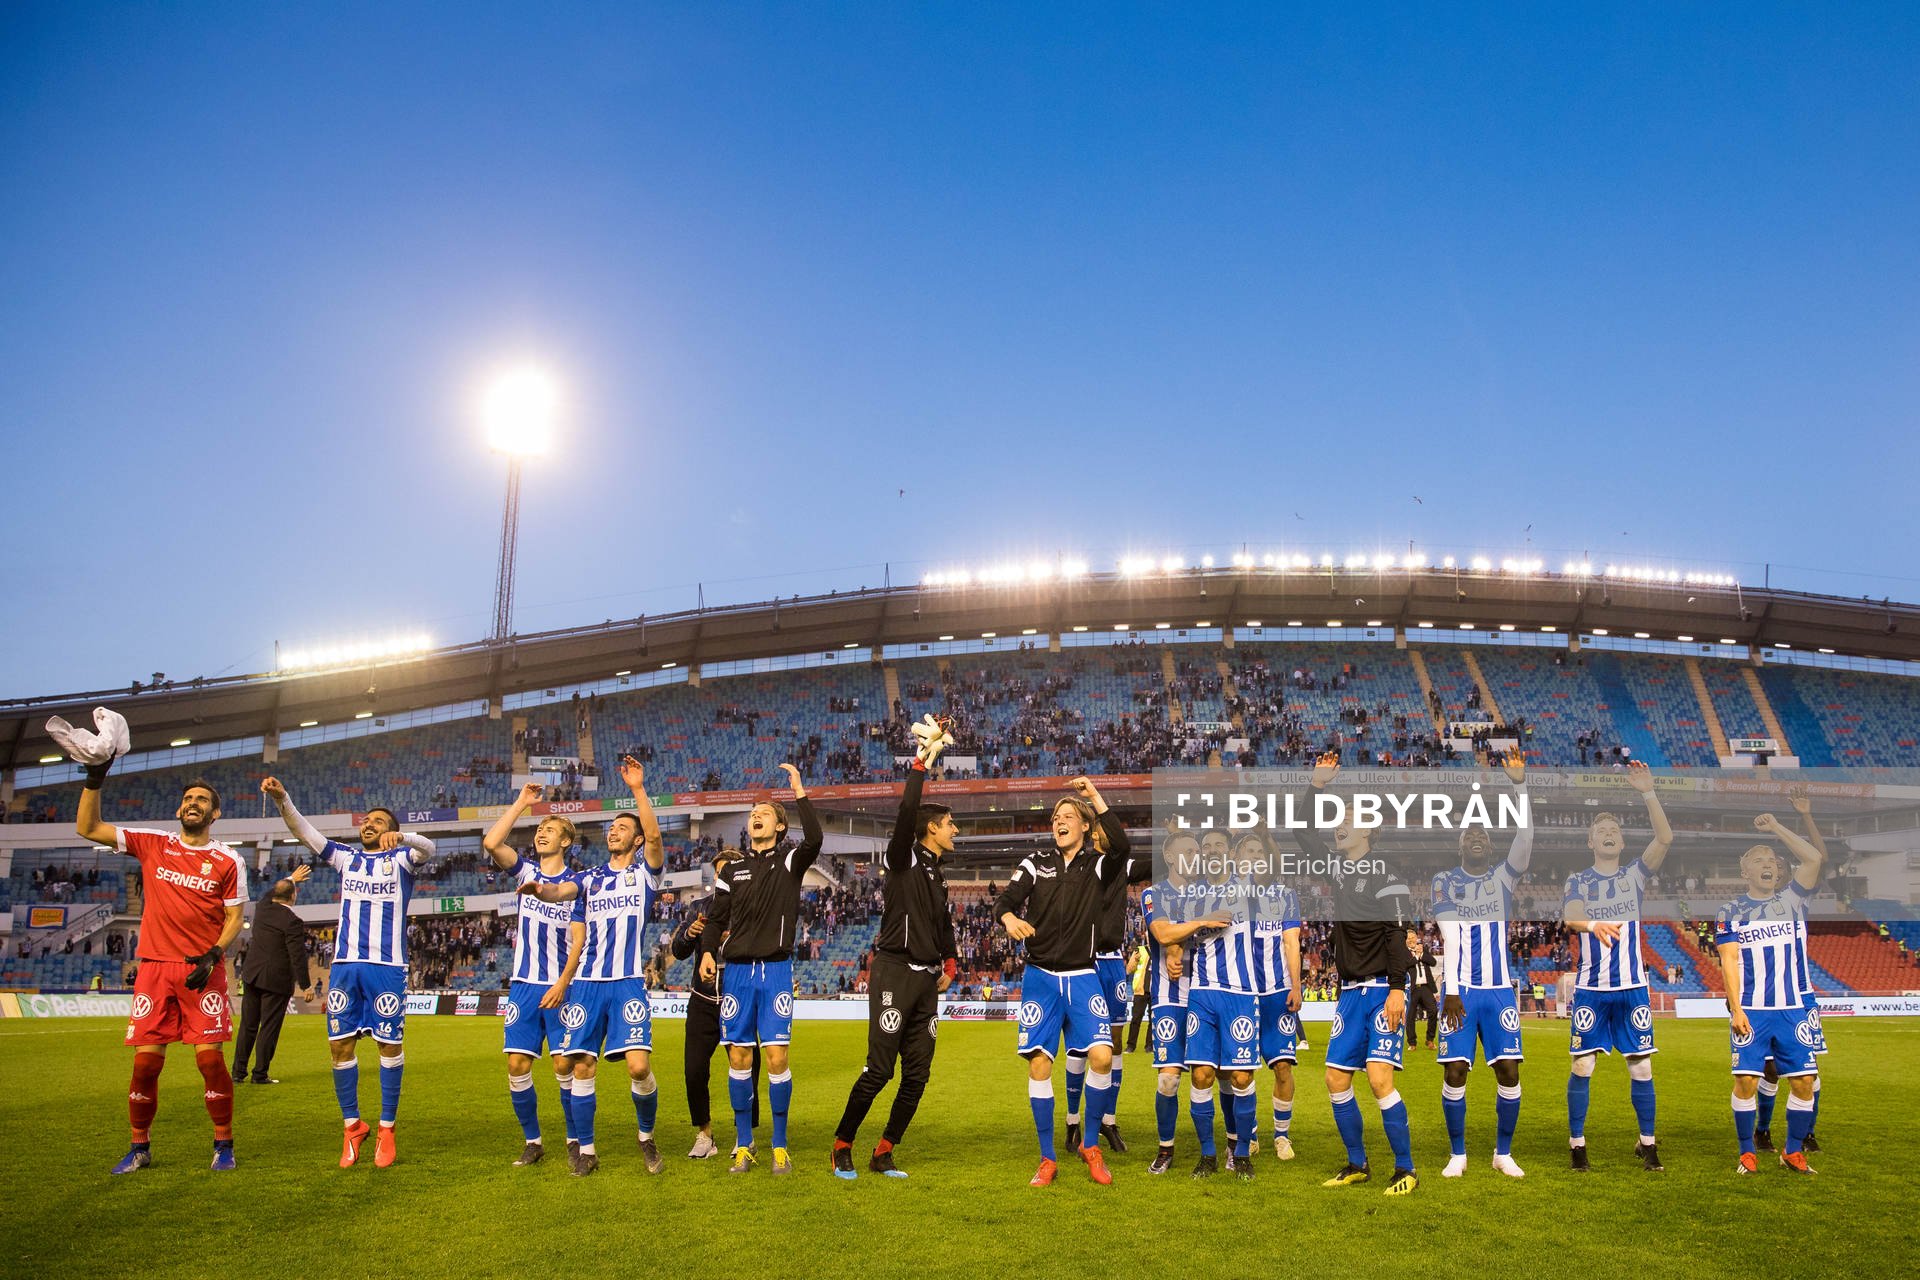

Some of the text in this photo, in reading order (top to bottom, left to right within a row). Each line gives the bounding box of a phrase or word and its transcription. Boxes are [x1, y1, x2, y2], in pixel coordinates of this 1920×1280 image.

[1279, 772, 1312, 783] Ullev
[1358, 772, 1396, 783] Ullevi
[1437, 772, 1475, 784] Ullevi
[1527, 773, 1554, 785] llevi
[1582, 775, 1597, 783] Dit
[1600, 775, 1611, 783] du
[1654, 777, 1687, 786] du vill.
[1726, 781, 1757, 791] Renova
[1807, 784, 1838, 794] Renova
[550, 802, 585, 813] SHOP.
[408, 810, 434, 823] EAT.
[156, 866, 218, 893] SERNEKE
[343, 878, 397, 895] SERNEKE
[588, 894, 641, 914] SERNEKE
[1586, 900, 1636, 920] SERNEKE
[1256, 919, 1282, 931] NEKE
[1738, 922, 1792, 944] SERNEKE
[1870, 1001, 1920, 1011] www.be
[215, 1016, 223, 1028] 1
[378, 1021, 392, 1033] 16
[629, 1027, 644, 1039] 22
[1098, 1023, 1111, 1034] 23
[1287, 1041, 1295, 1050] 4
[1377, 1038, 1393, 1051] 19
[1639, 1035, 1651, 1046] 20
[1236, 1047, 1251, 1059] 26
